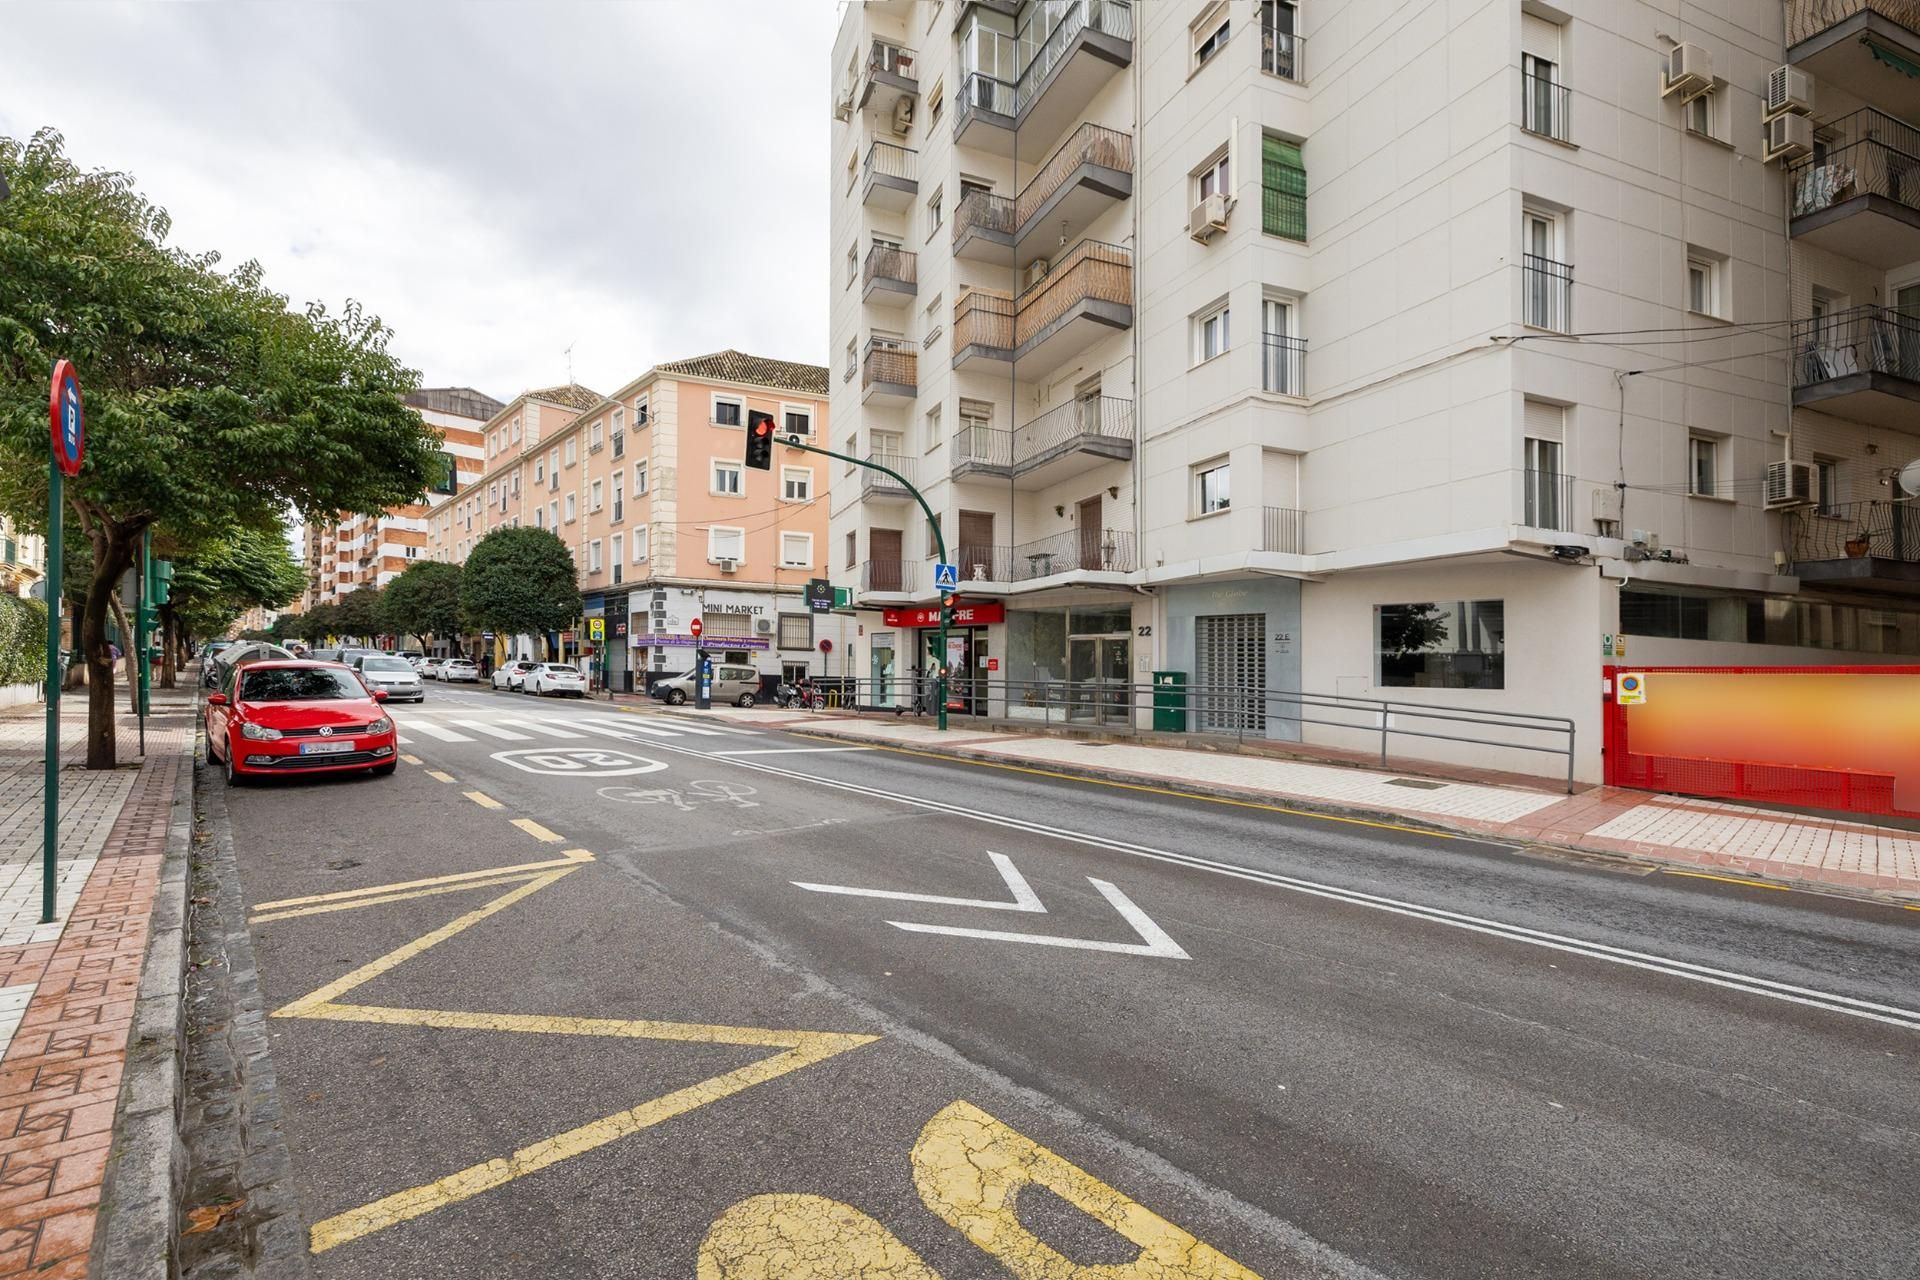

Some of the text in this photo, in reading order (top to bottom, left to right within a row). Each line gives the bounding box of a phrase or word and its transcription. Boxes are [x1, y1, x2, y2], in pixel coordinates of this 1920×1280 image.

[703, 604, 764, 615] MINI MARKET
[1138, 626, 1152, 636] 22
[1274, 633, 1290, 641] 22 E
